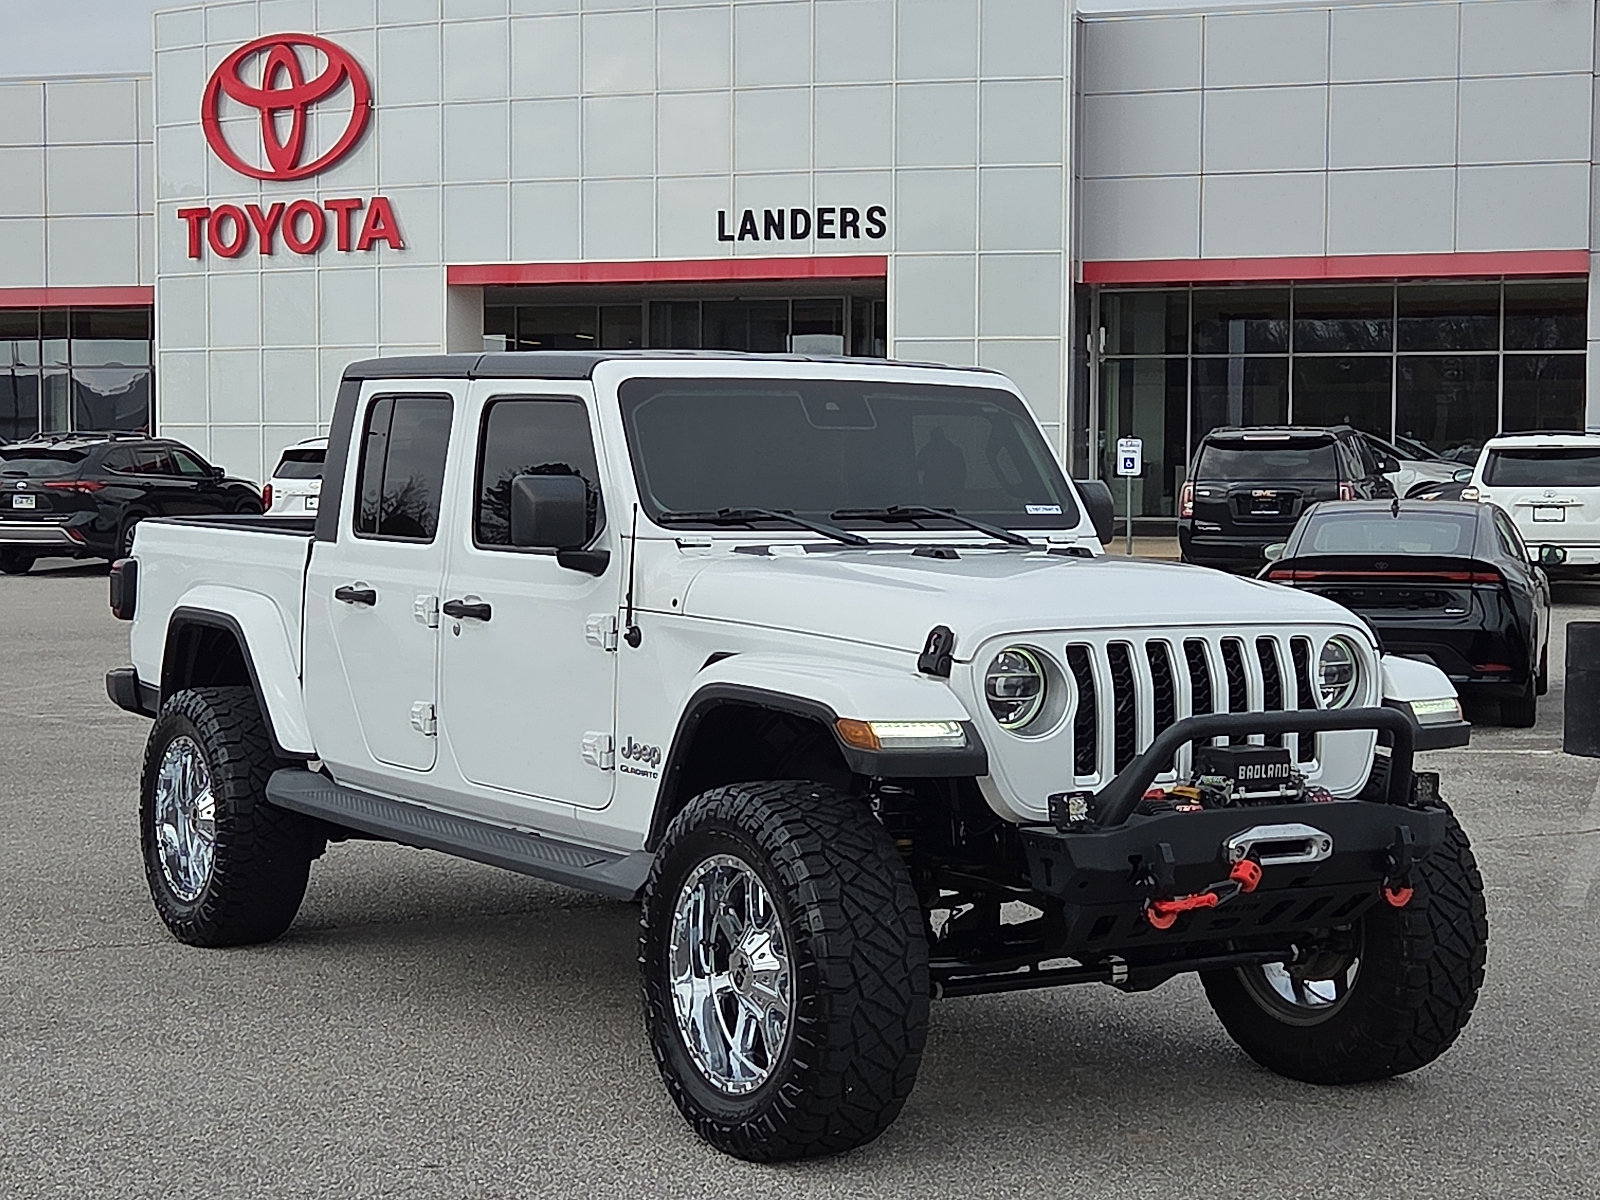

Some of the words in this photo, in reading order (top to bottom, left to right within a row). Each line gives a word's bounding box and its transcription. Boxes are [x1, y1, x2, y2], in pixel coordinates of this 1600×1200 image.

[178, 197, 404, 258] TOYOTA
[718, 206, 887, 240] LANDERS
[621, 736, 661, 768] Jeep
[1239, 764, 1289, 779] BADLAND
